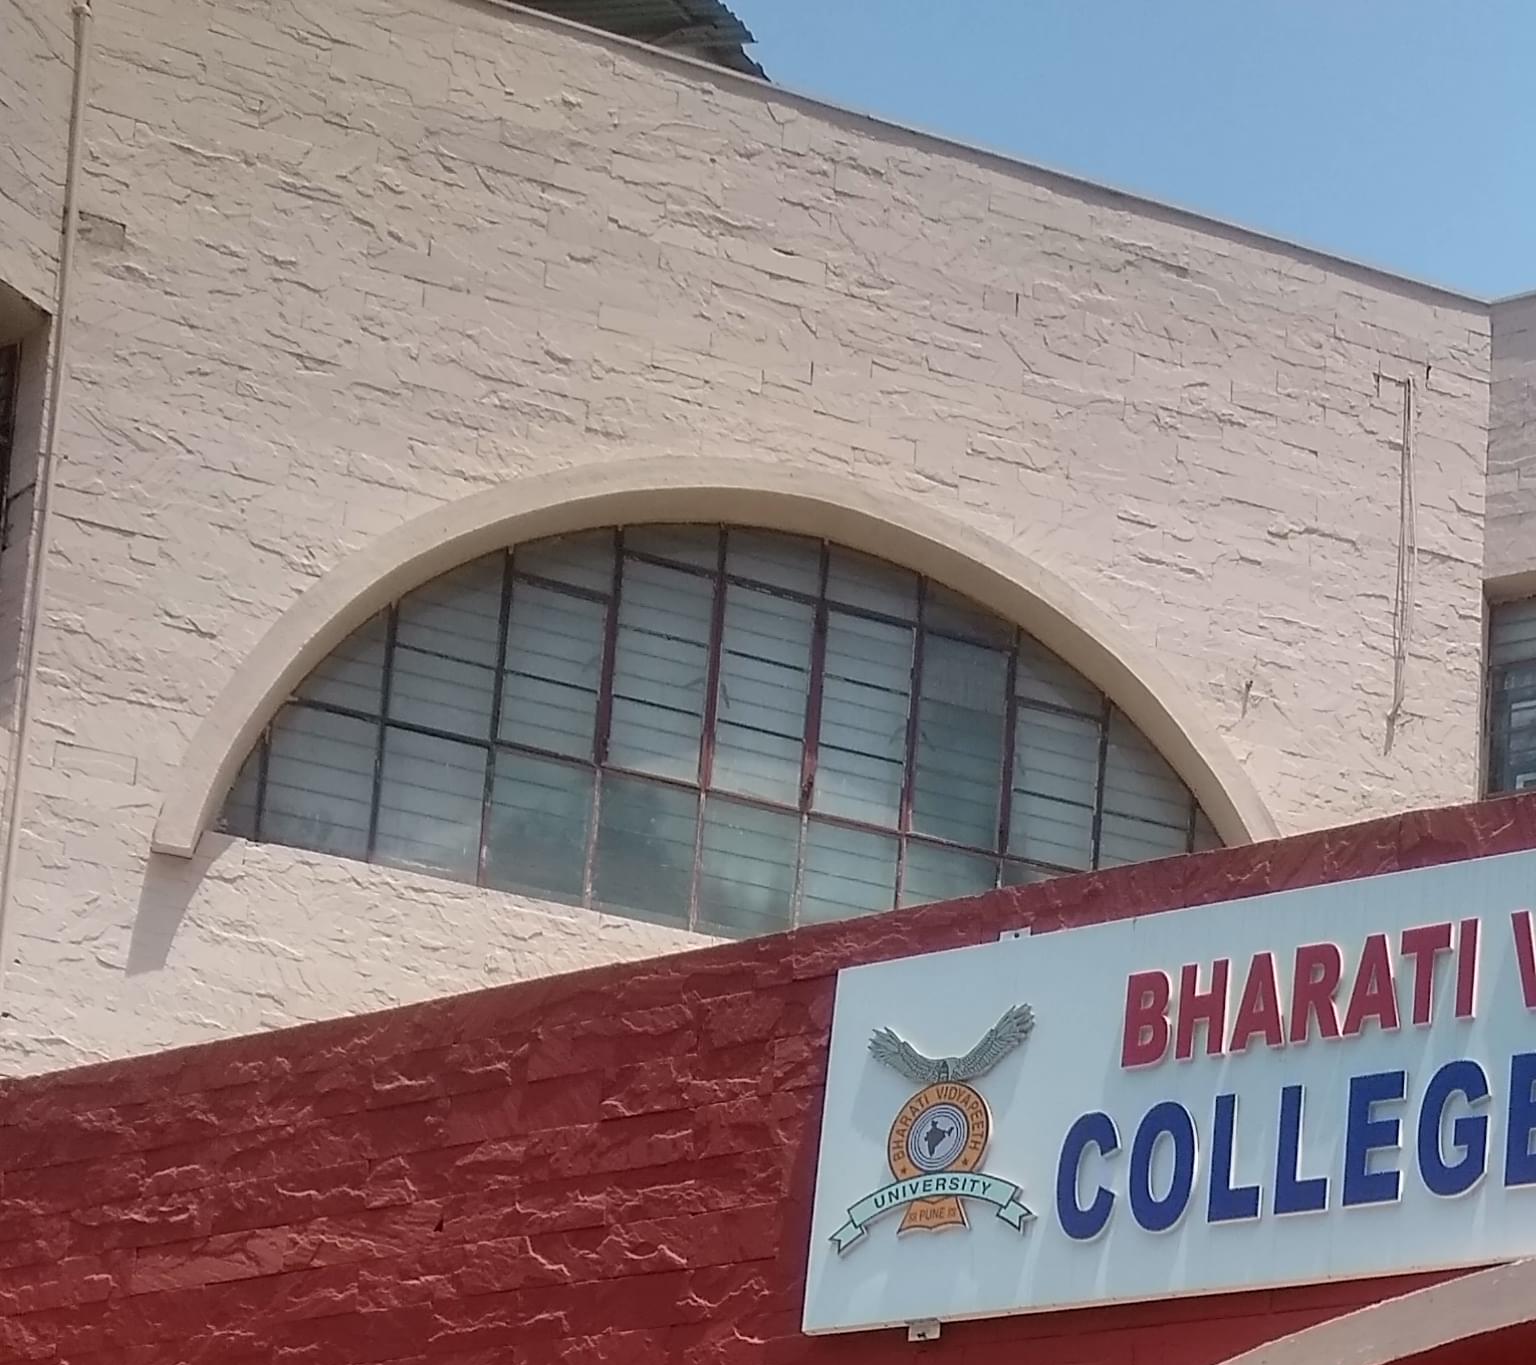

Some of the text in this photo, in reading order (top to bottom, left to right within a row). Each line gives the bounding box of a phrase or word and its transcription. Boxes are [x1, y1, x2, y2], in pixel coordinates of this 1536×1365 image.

[1121, 917, 1479, 1068] BHARATI
[893, 1084, 986, 1163] BHARATI VIDYAPEETH
[873, 1176, 993, 1210] UNIVERSITY
[919, 1206, 946, 1221] PUNE
